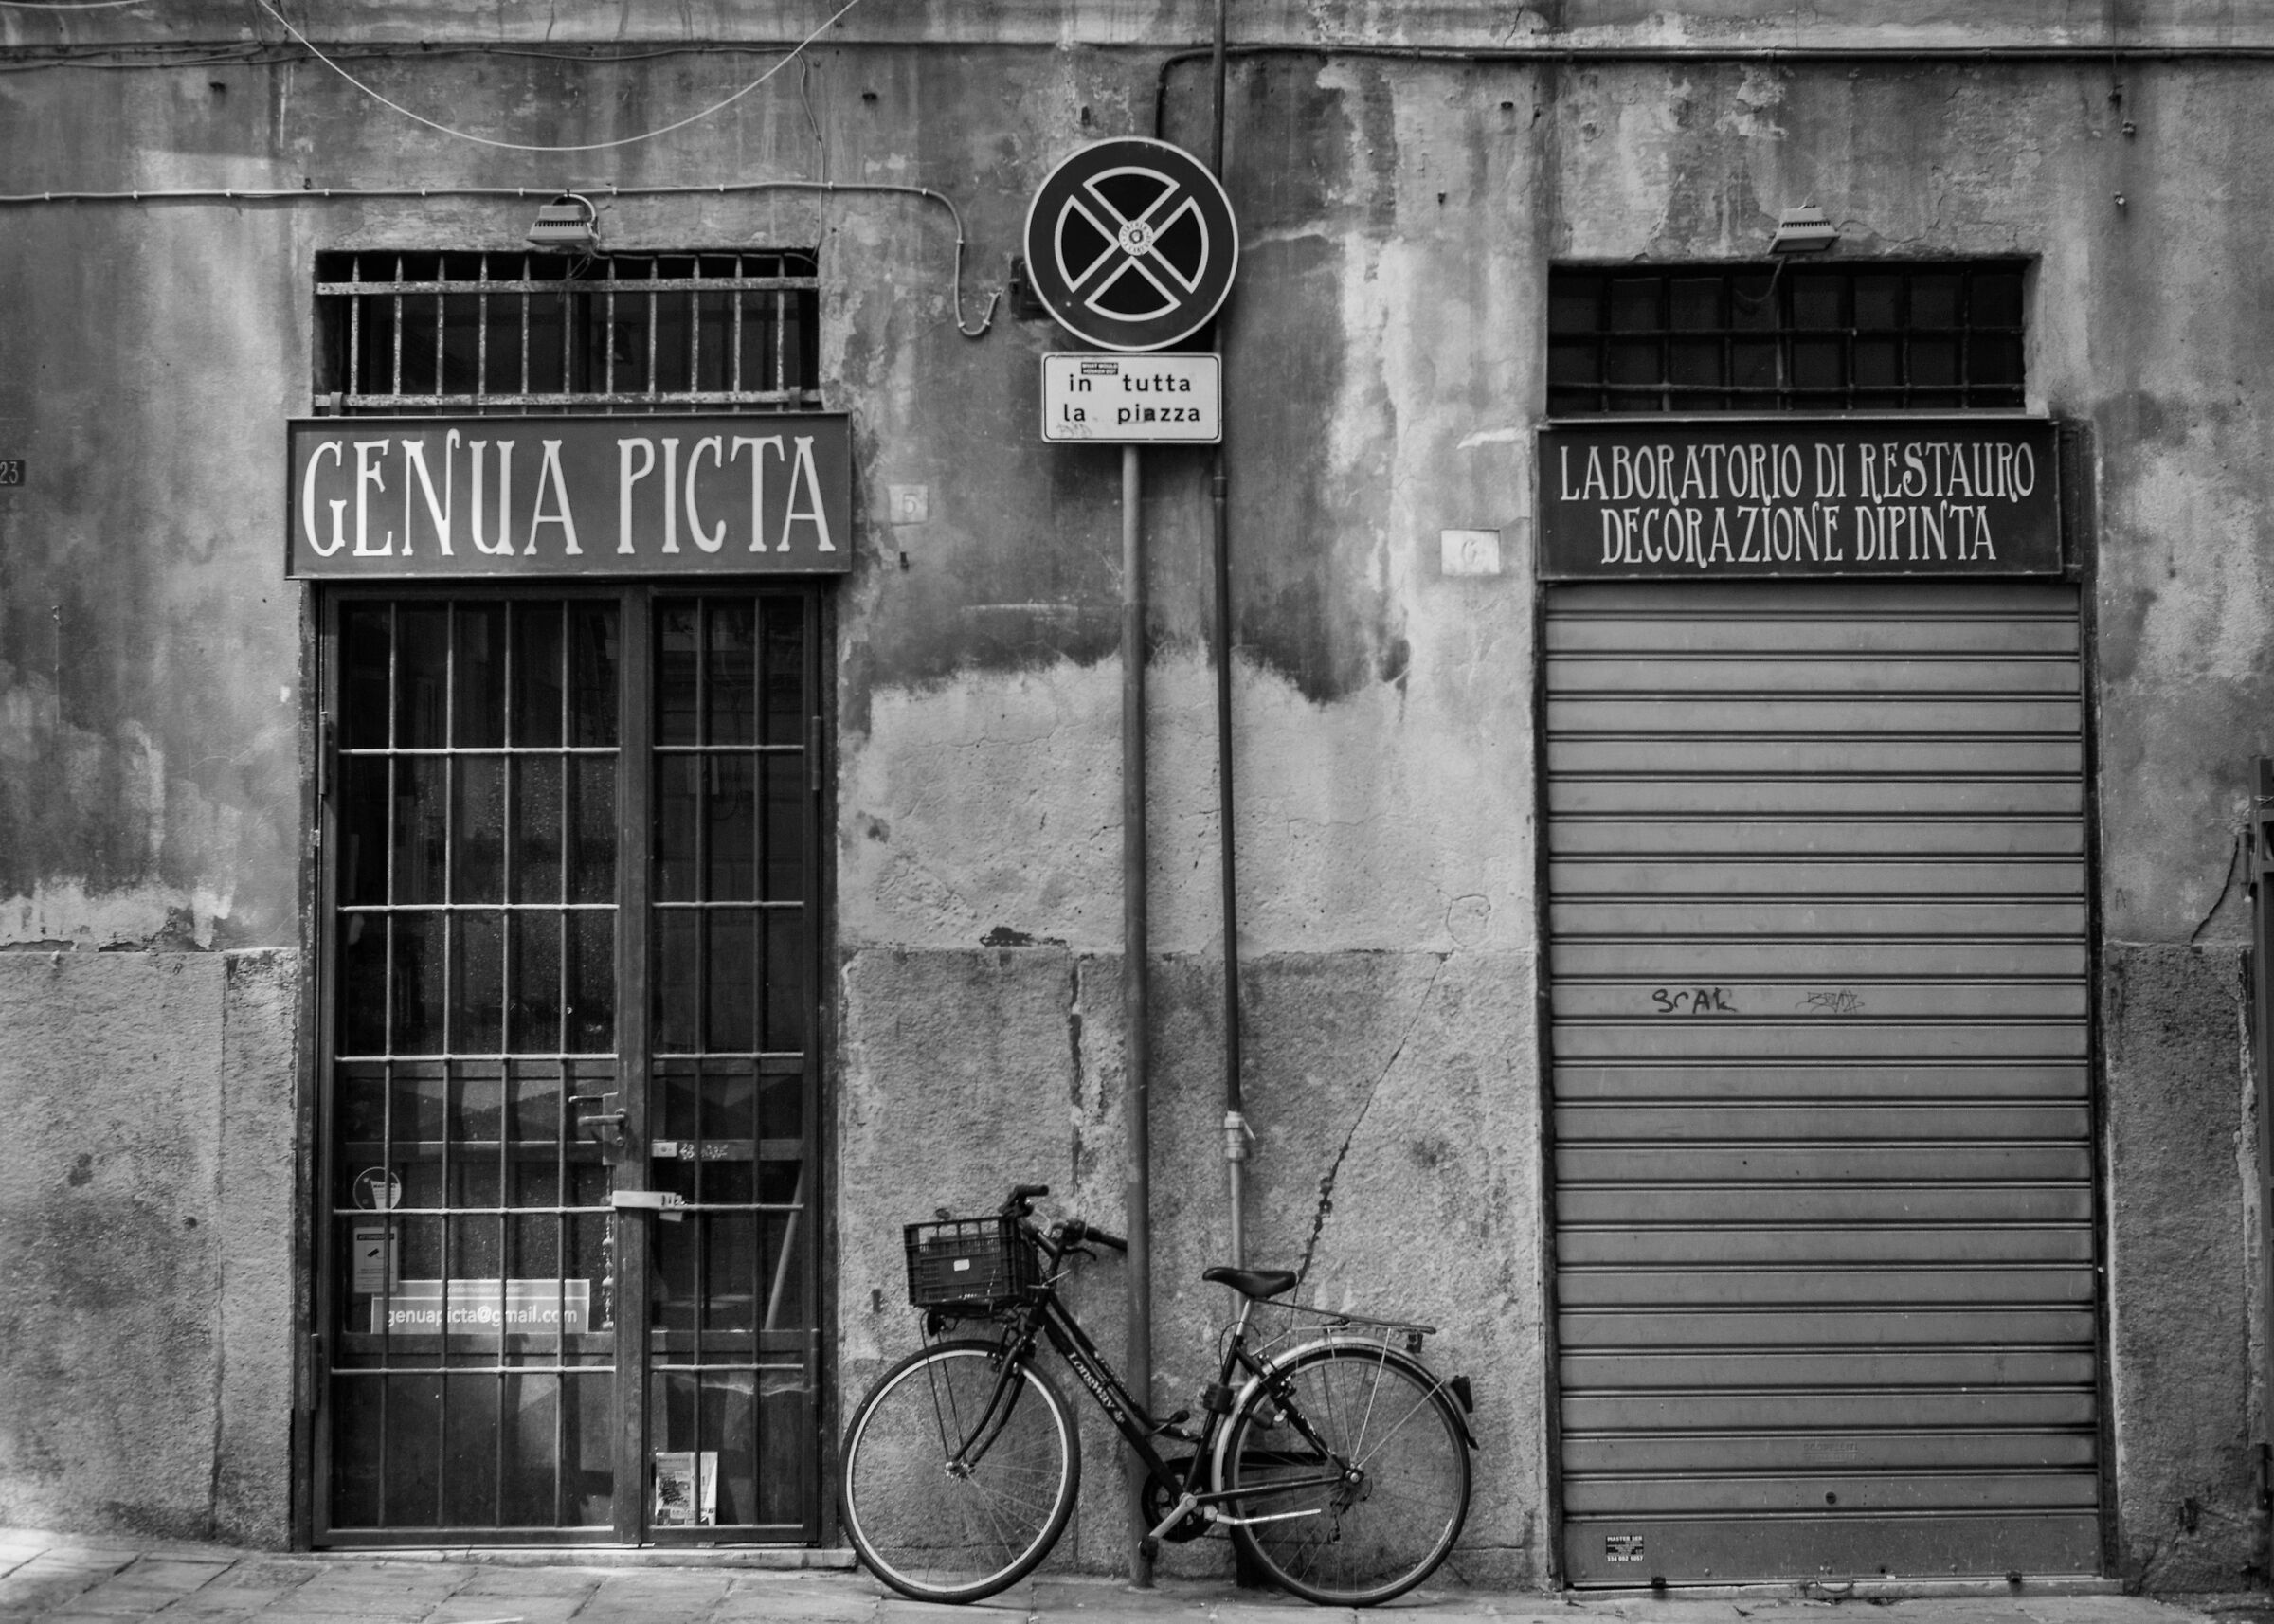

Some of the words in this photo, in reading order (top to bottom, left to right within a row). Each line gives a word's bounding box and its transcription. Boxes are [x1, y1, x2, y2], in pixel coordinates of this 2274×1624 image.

[1069, 373, 1092, 392] in
[1122, 373, 1191, 392] tutta
[1063, 403, 1086, 422] la
[1117, 404, 1200, 425] piazza
[302, 428, 583, 557] GENUA
[616, 434, 836, 554] PICTA
[1560, 443, 1802, 506] LABORATORIO
[1814, 442, 1847, 499] DI
[1859, 441, 2035, 504] RESTAURO
[1600, 500, 1843, 568] DECORAZIONE
[1855, 499, 1996, 562] DIPINTA
[388, 1305, 578, 1327] genuapicta@gmail.com
